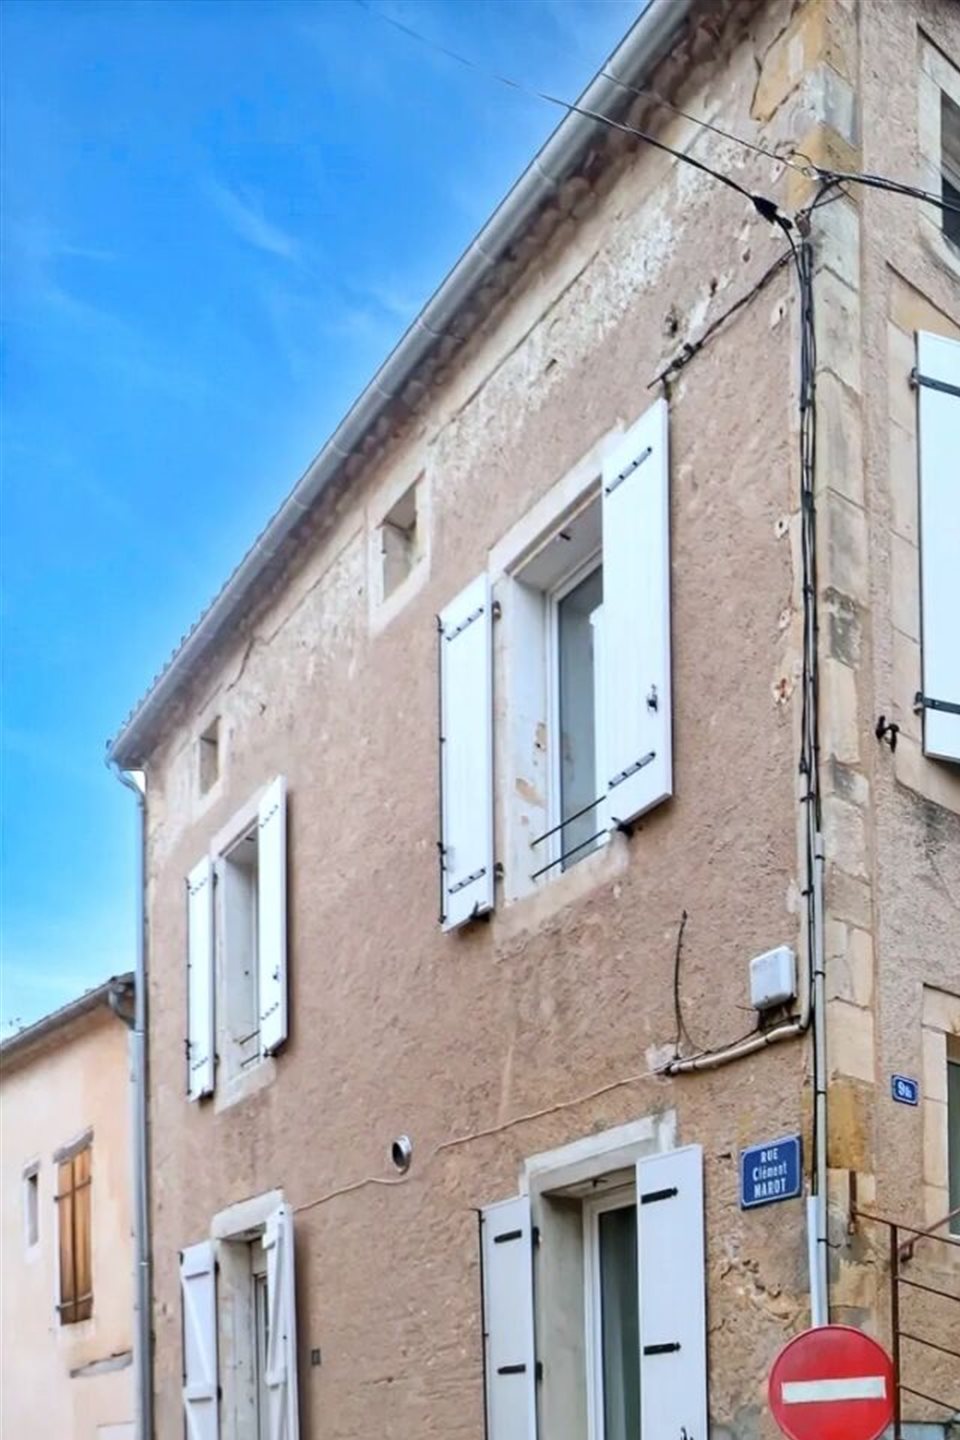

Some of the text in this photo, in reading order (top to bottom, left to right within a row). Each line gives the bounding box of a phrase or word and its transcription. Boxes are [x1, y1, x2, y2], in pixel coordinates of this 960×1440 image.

[761, 1148, 778, 1163] RUE
[752, 1161, 787, 1181] Clément
[754, 1178, 786, 1198] MAROT
